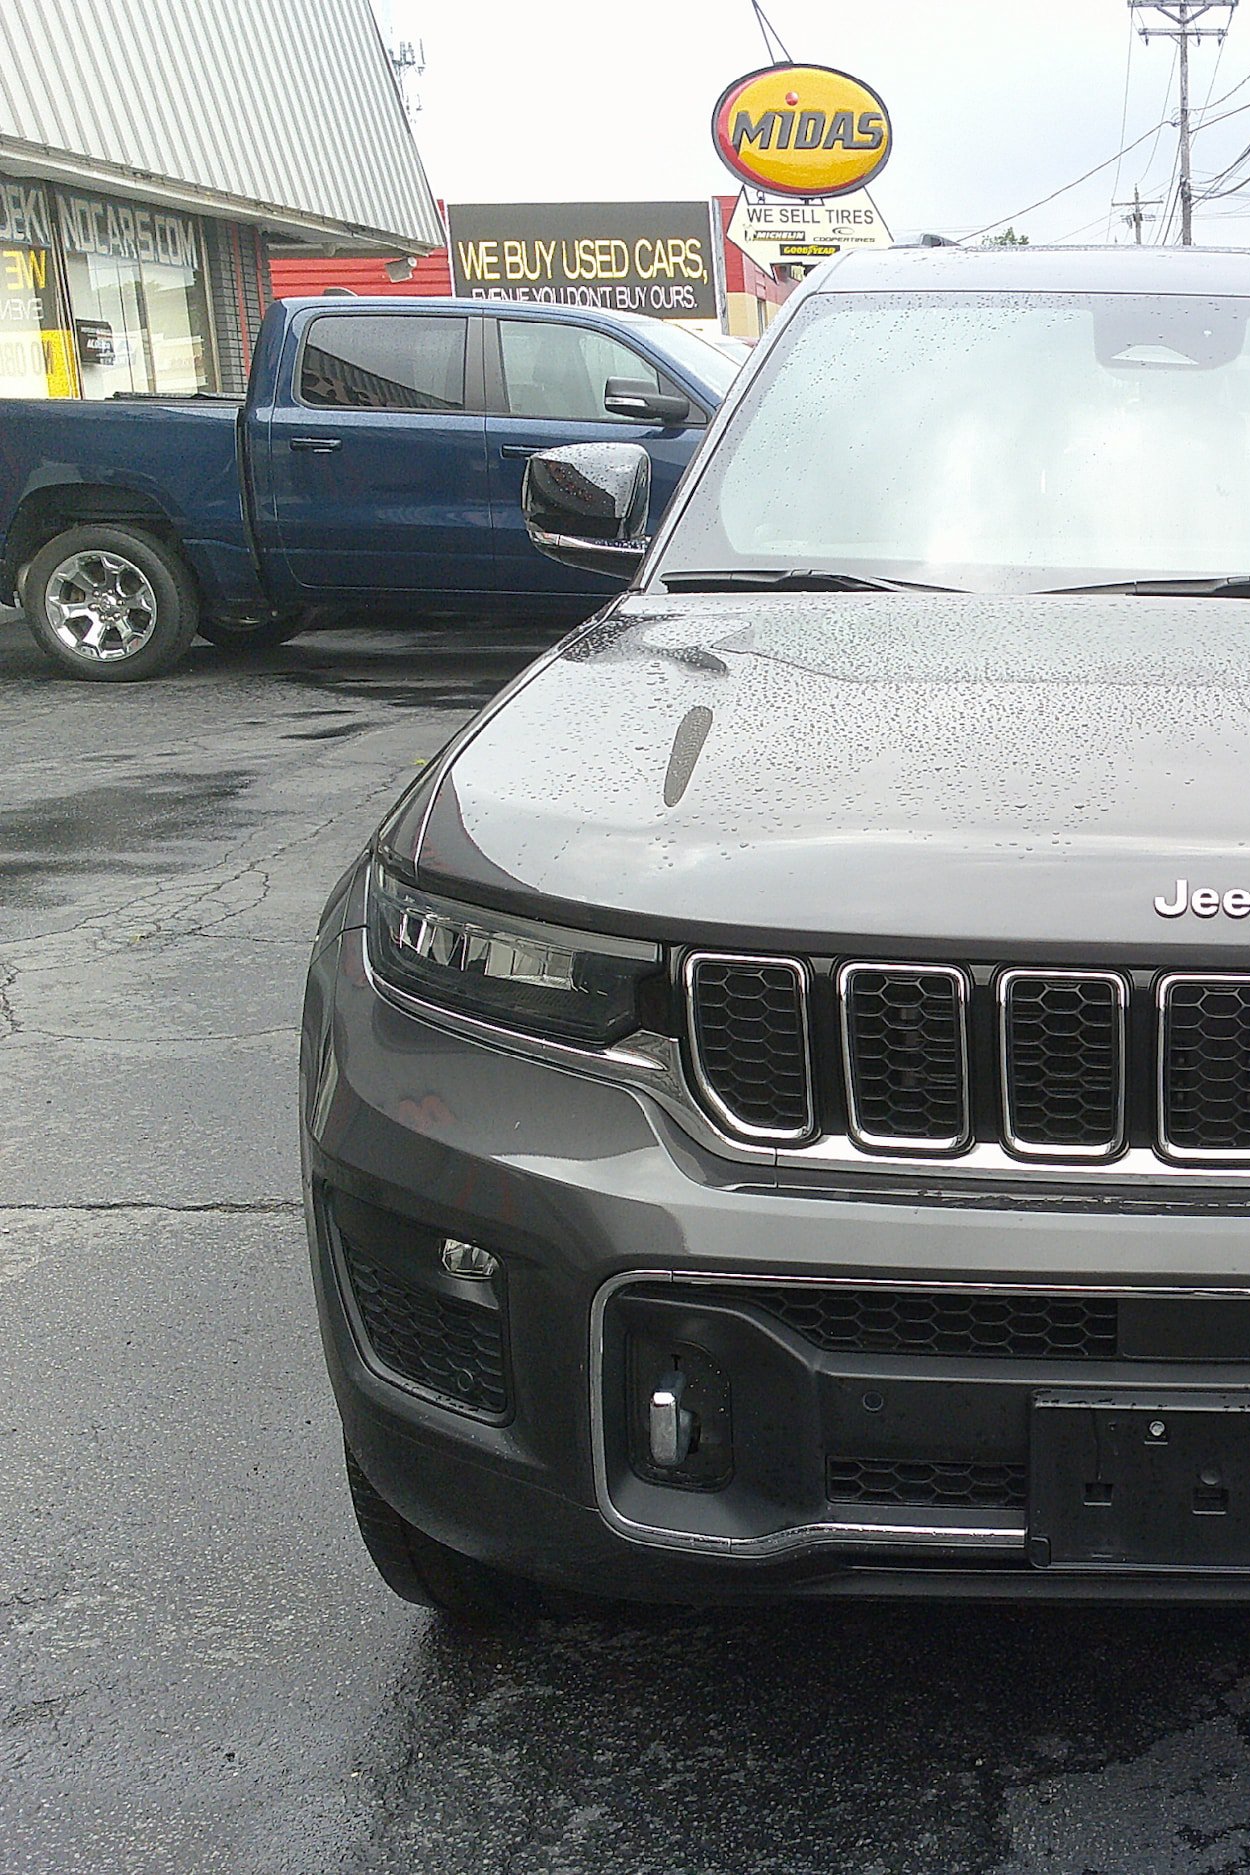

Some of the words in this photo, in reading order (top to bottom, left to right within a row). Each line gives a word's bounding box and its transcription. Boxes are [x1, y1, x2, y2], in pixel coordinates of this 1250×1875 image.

[731, 109, 884, 152] MIDAS
[747, 208, 774, 224] WE
[779, 208, 820, 224] SELL
[826, 209, 874, 225] TIRES
[756, 231, 805, 241] MICHELIN
[458, 240, 501, 281] WE
[504, 240, 556, 280] BUY
[562, 239, 628, 280] USED
[635, 238, 708, 285] CARS,
[616, 286, 647, 309] BUY
[650, 285, 698, 309] OURS.
